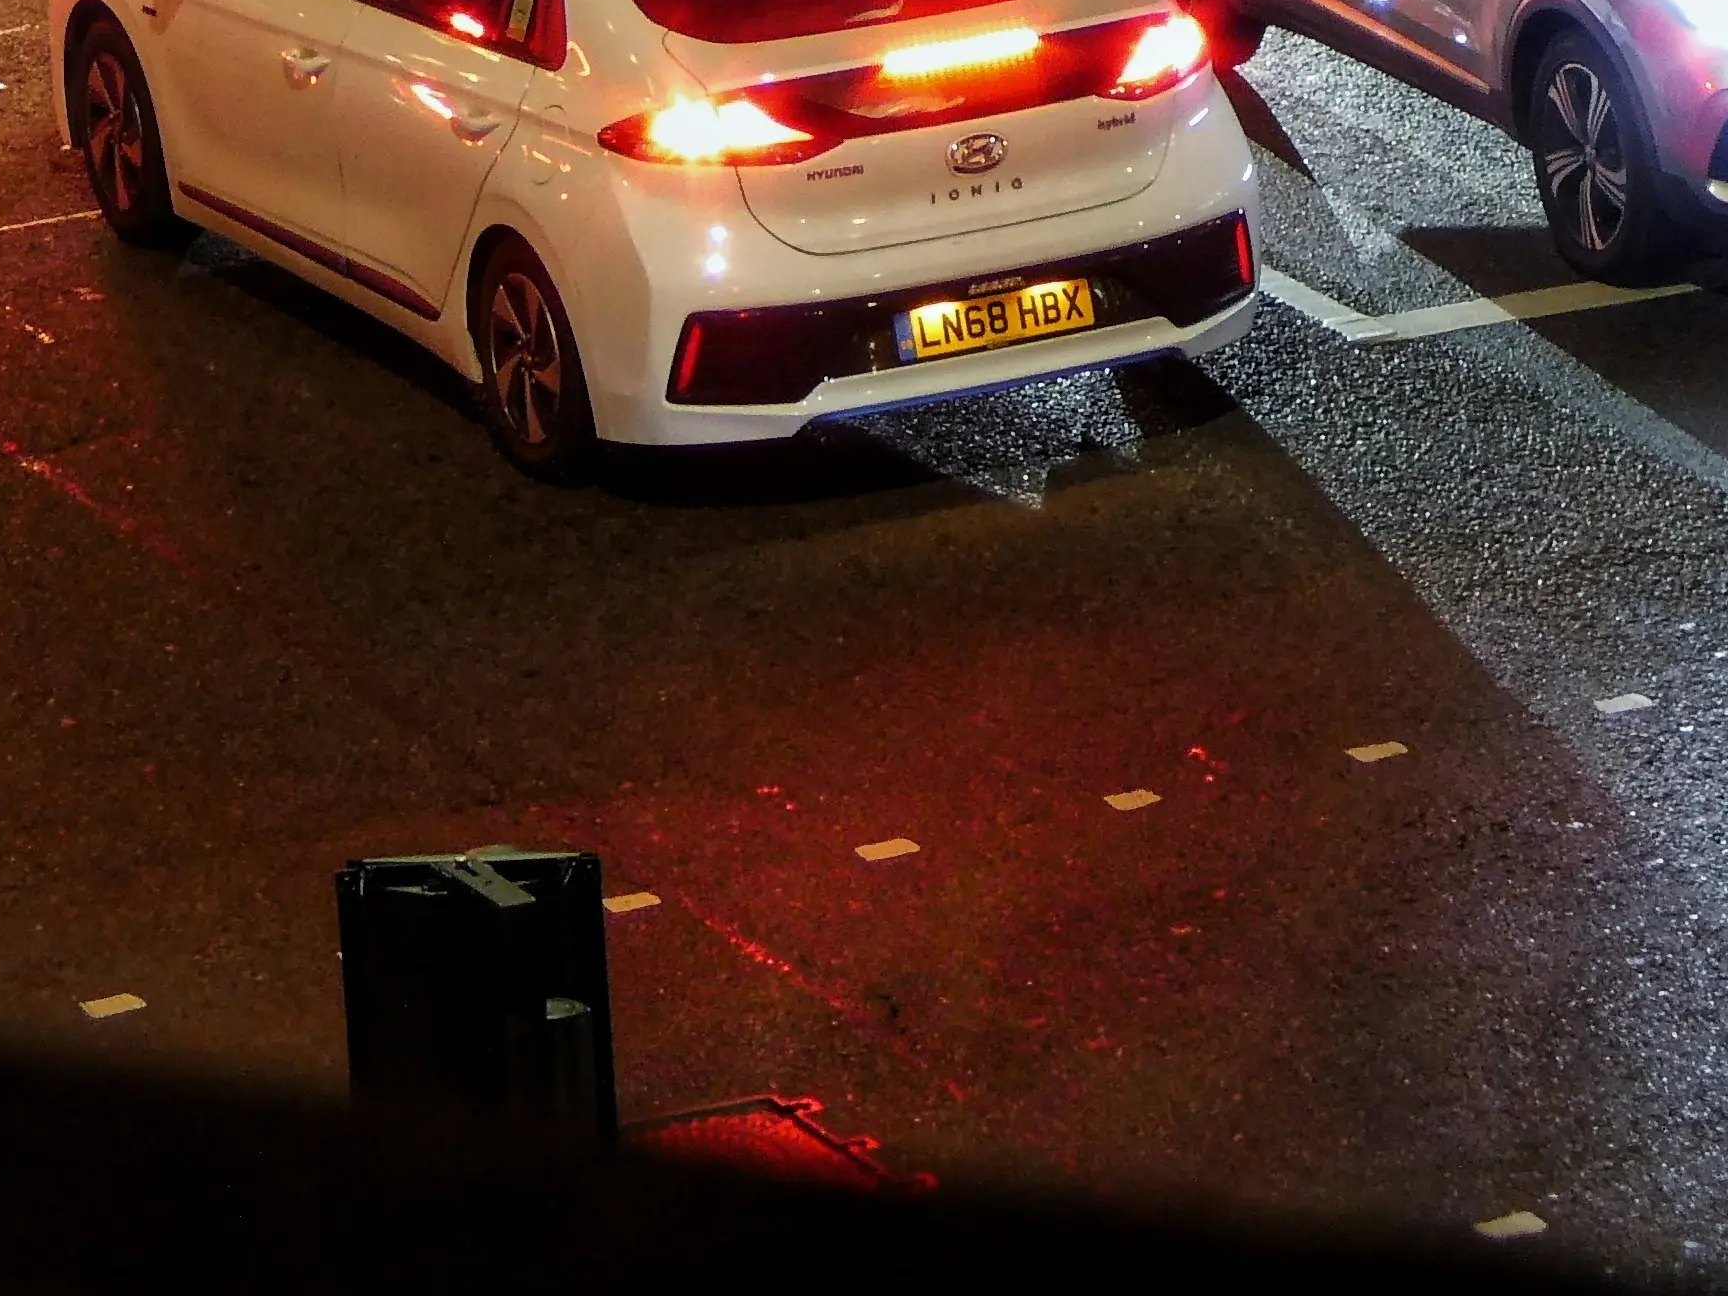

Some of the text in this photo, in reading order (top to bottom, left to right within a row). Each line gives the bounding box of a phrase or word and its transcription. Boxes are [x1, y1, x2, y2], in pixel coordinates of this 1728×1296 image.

[806, 164, 864, 181] HYUNDAI
[931, 177, 1023, 205] IONIQ
[918, 300, 1010, 348] LN68
[1016, 285, 1085, 330] HBX
